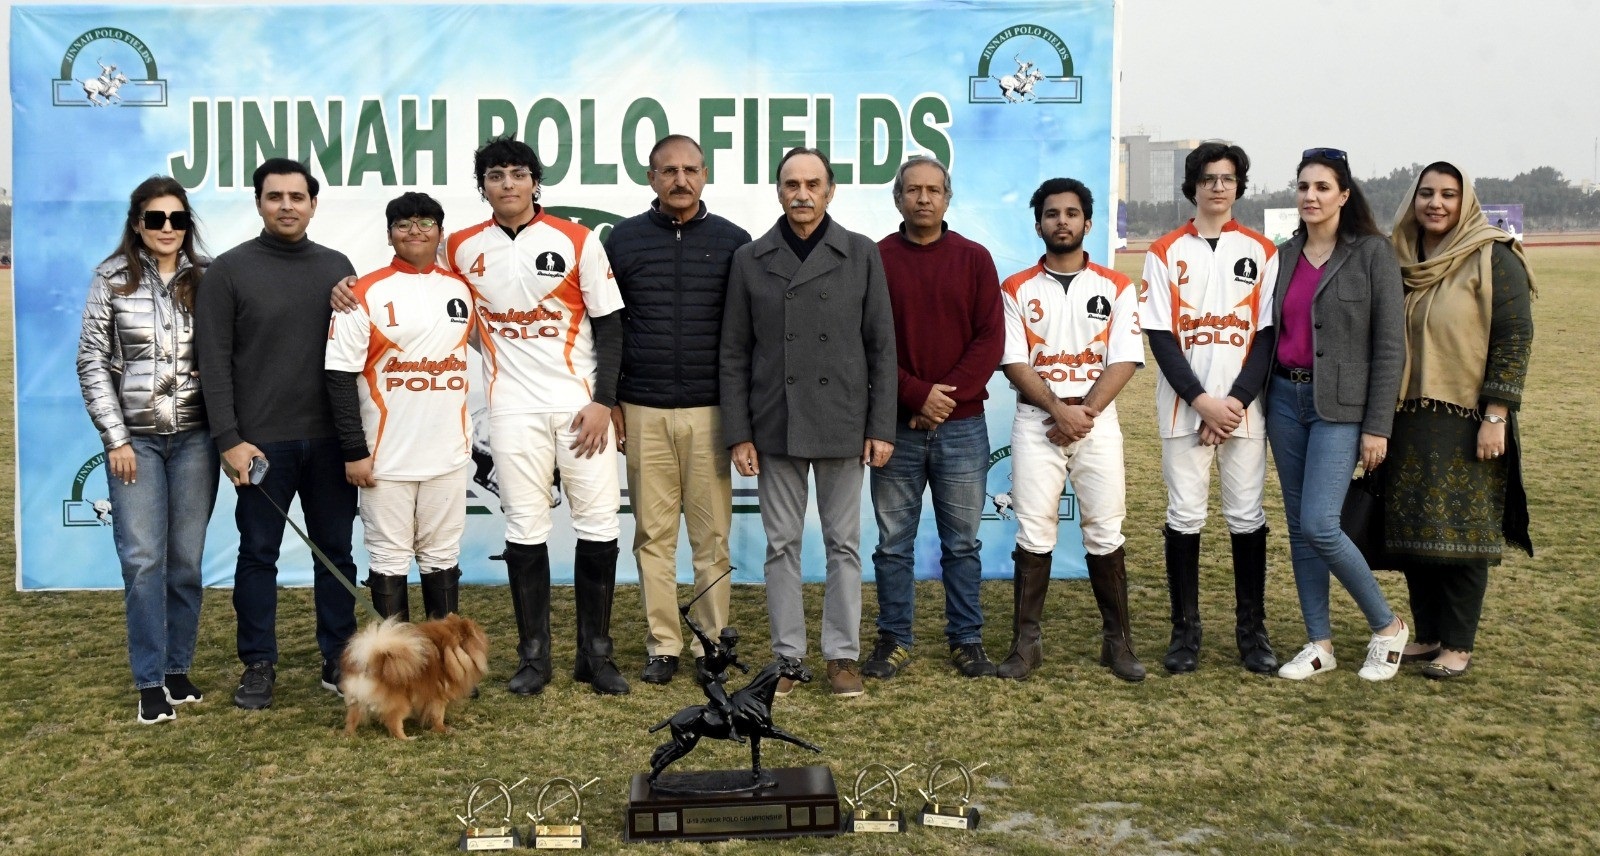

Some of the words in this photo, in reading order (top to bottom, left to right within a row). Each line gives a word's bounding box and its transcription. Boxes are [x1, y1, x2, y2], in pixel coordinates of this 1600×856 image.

[65, 33, 94, 63] JINNAH
[95, 29, 123, 39] POLO
[124, 35, 153, 64] FIELDS
[983, 30, 1012, 60] JINNAH
[1014, 26, 1042, 36] POLO
[1042, 32, 1069, 60] FIELDS
[170, 99, 448, 188] JINNAH
[477, 97, 671, 186] POLO
[699, 97, 952, 186] FIELDS
[469, 253, 486, 277] 4
[1176, 260, 1189, 285] 2
[1139, 279, 1149, 303] 2
[384, 301, 399, 327] 1
[1027, 298, 1044, 324] 3
[1130, 311, 1141, 335] 3
[1185, 330, 1245, 351] POLO
[385, 376, 465, 392] POLO
[76, 454, 104, 484] JINNAH
[723, 814, 739, 822] POLO
